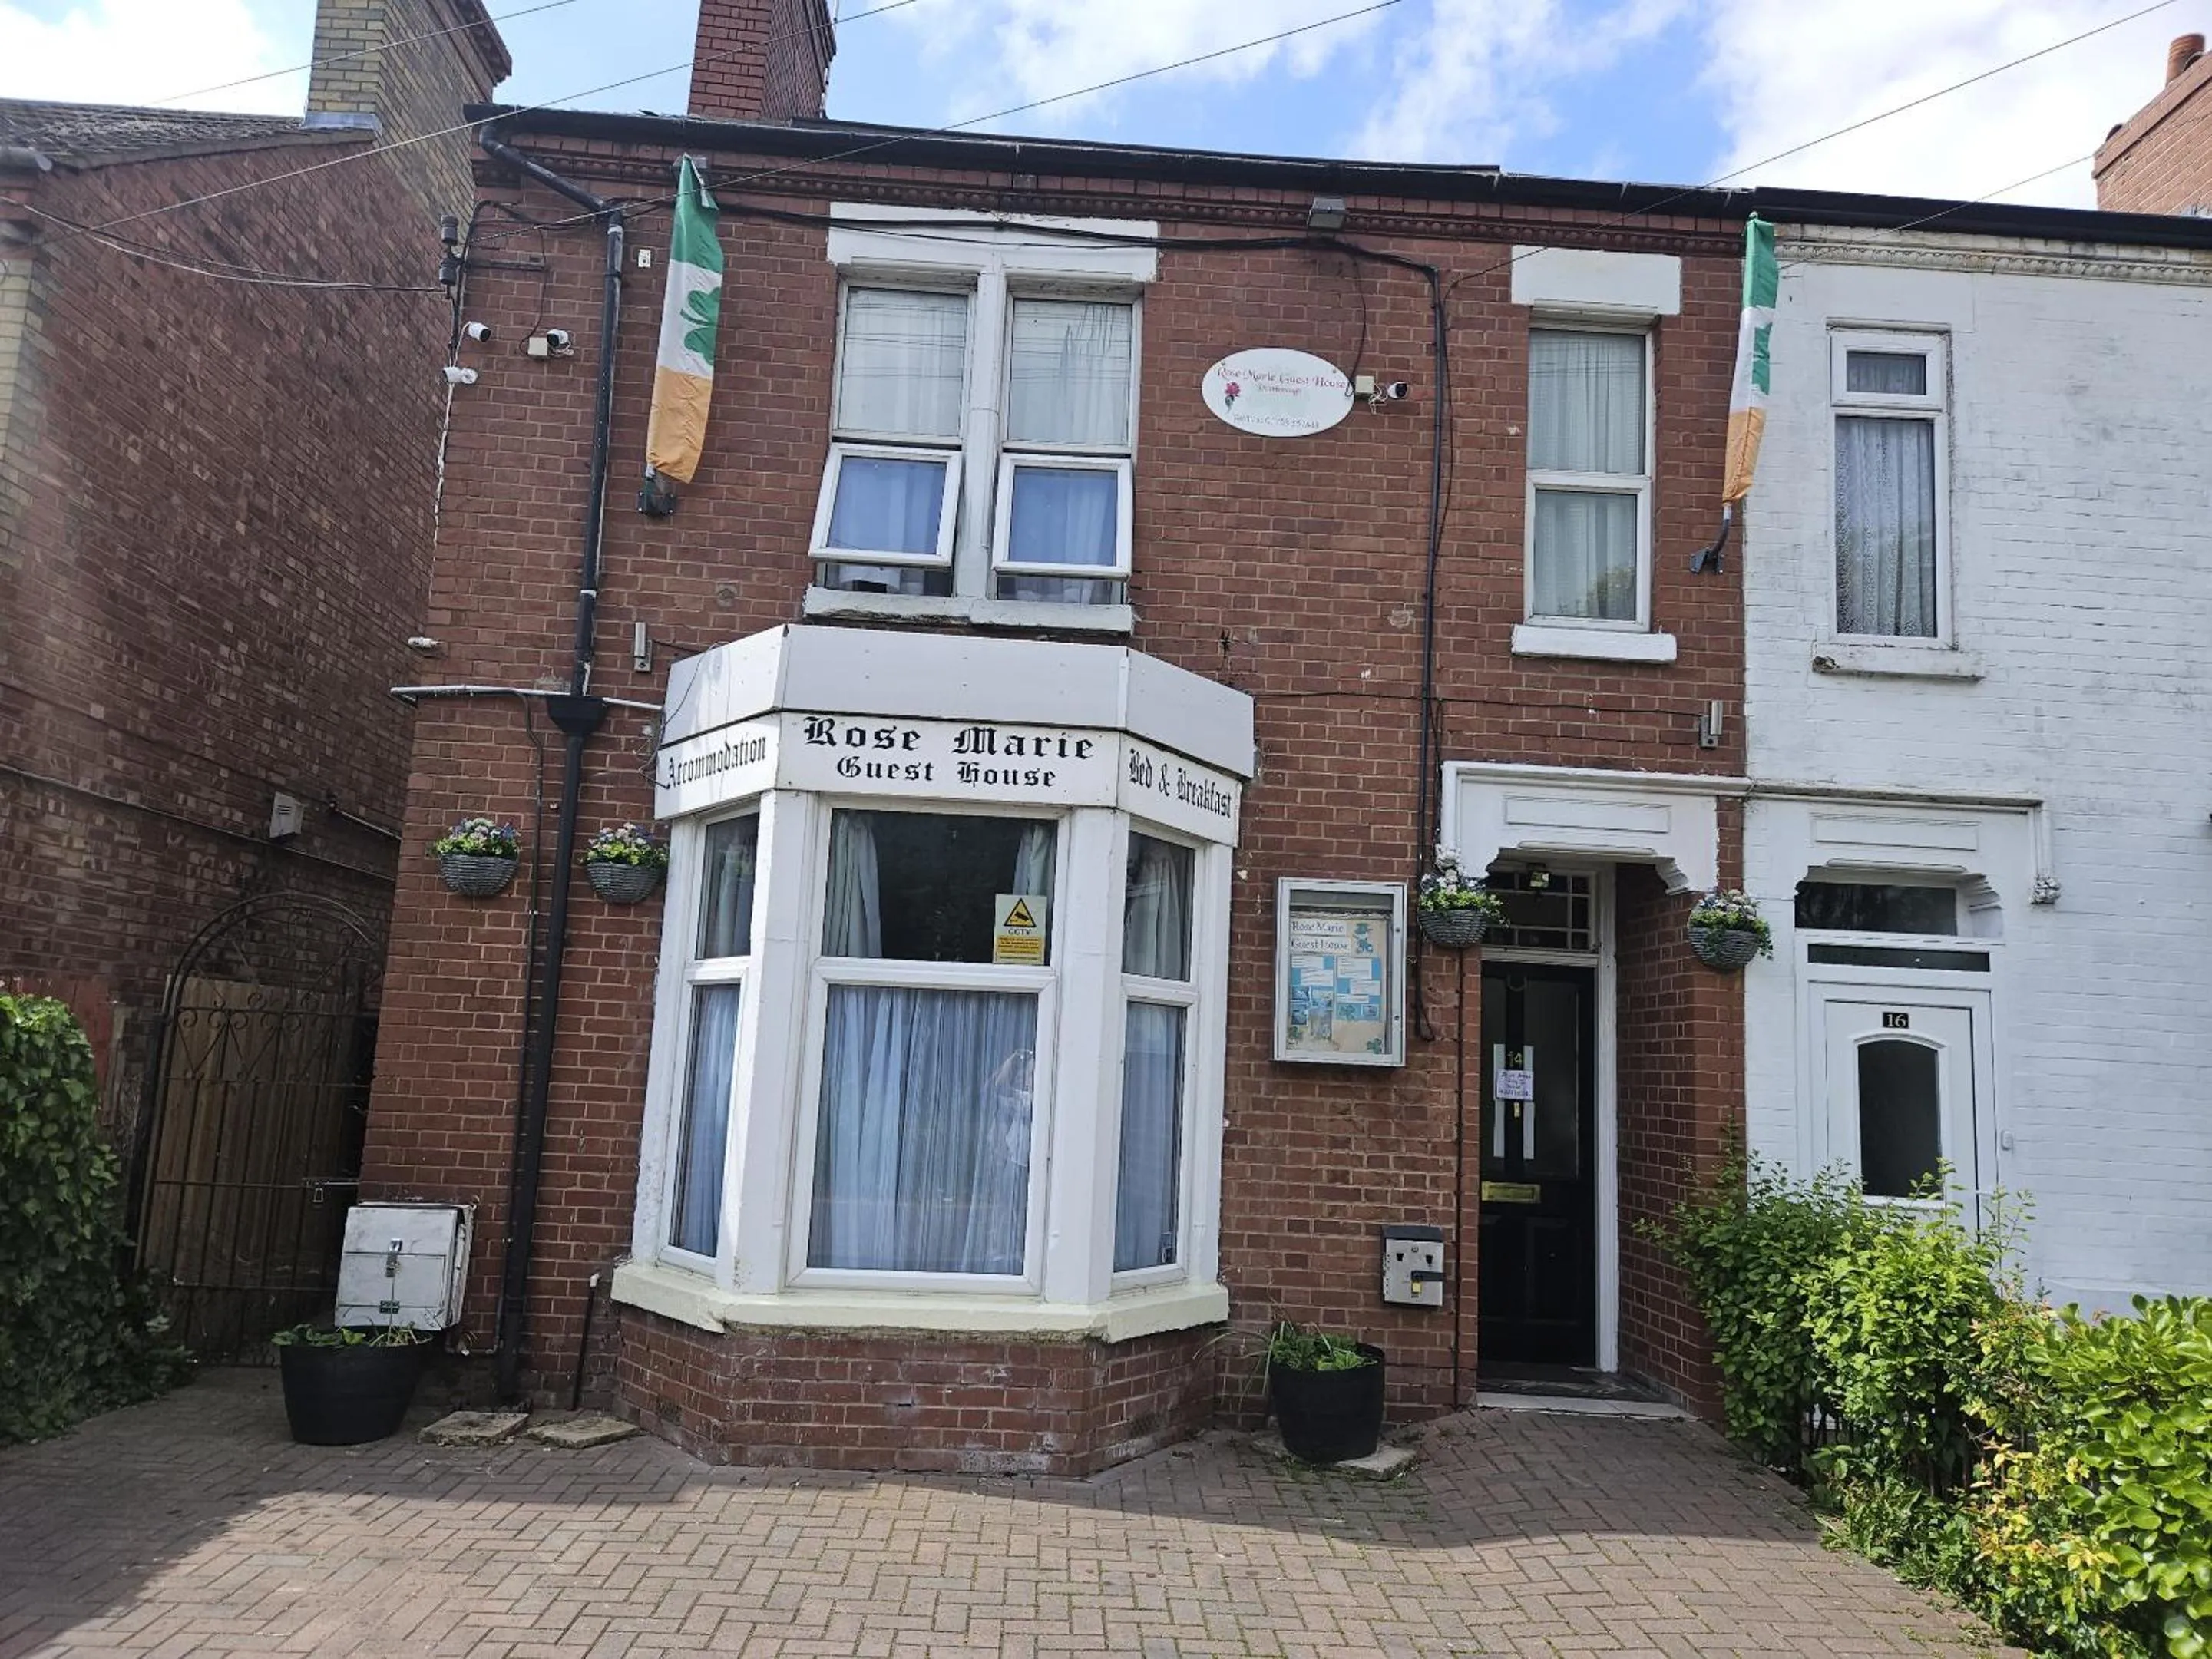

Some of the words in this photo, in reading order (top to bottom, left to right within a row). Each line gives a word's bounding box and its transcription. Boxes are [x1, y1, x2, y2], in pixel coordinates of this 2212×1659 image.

[1217, 367, 1242, 378] Rose
[1244, 368, 1276, 382] Marie
[1279, 373, 1309, 385] Guest
[1312, 375, 1345, 389] House
[803, 716, 921, 751] Rose
[952, 726, 1094, 760] Marie
[666, 735, 766, 788] Accommodation
[836, 755, 935, 782] Guest
[957, 761, 1056, 788] House
[1129, 748, 1152, 788] Bed
[1158, 762, 1171, 797] &
[1177, 767, 1232, 818] Breakfast
[1291, 920, 1314, 932] Rose
[1316, 921, 1344, 933] Marie
[1291, 937, 1318, 950] Guest
[1320, 939, 1347, 950] House
[1886, 1013, 1906, 1027] 16
[1507, 1050, 1523, 1068] 14
